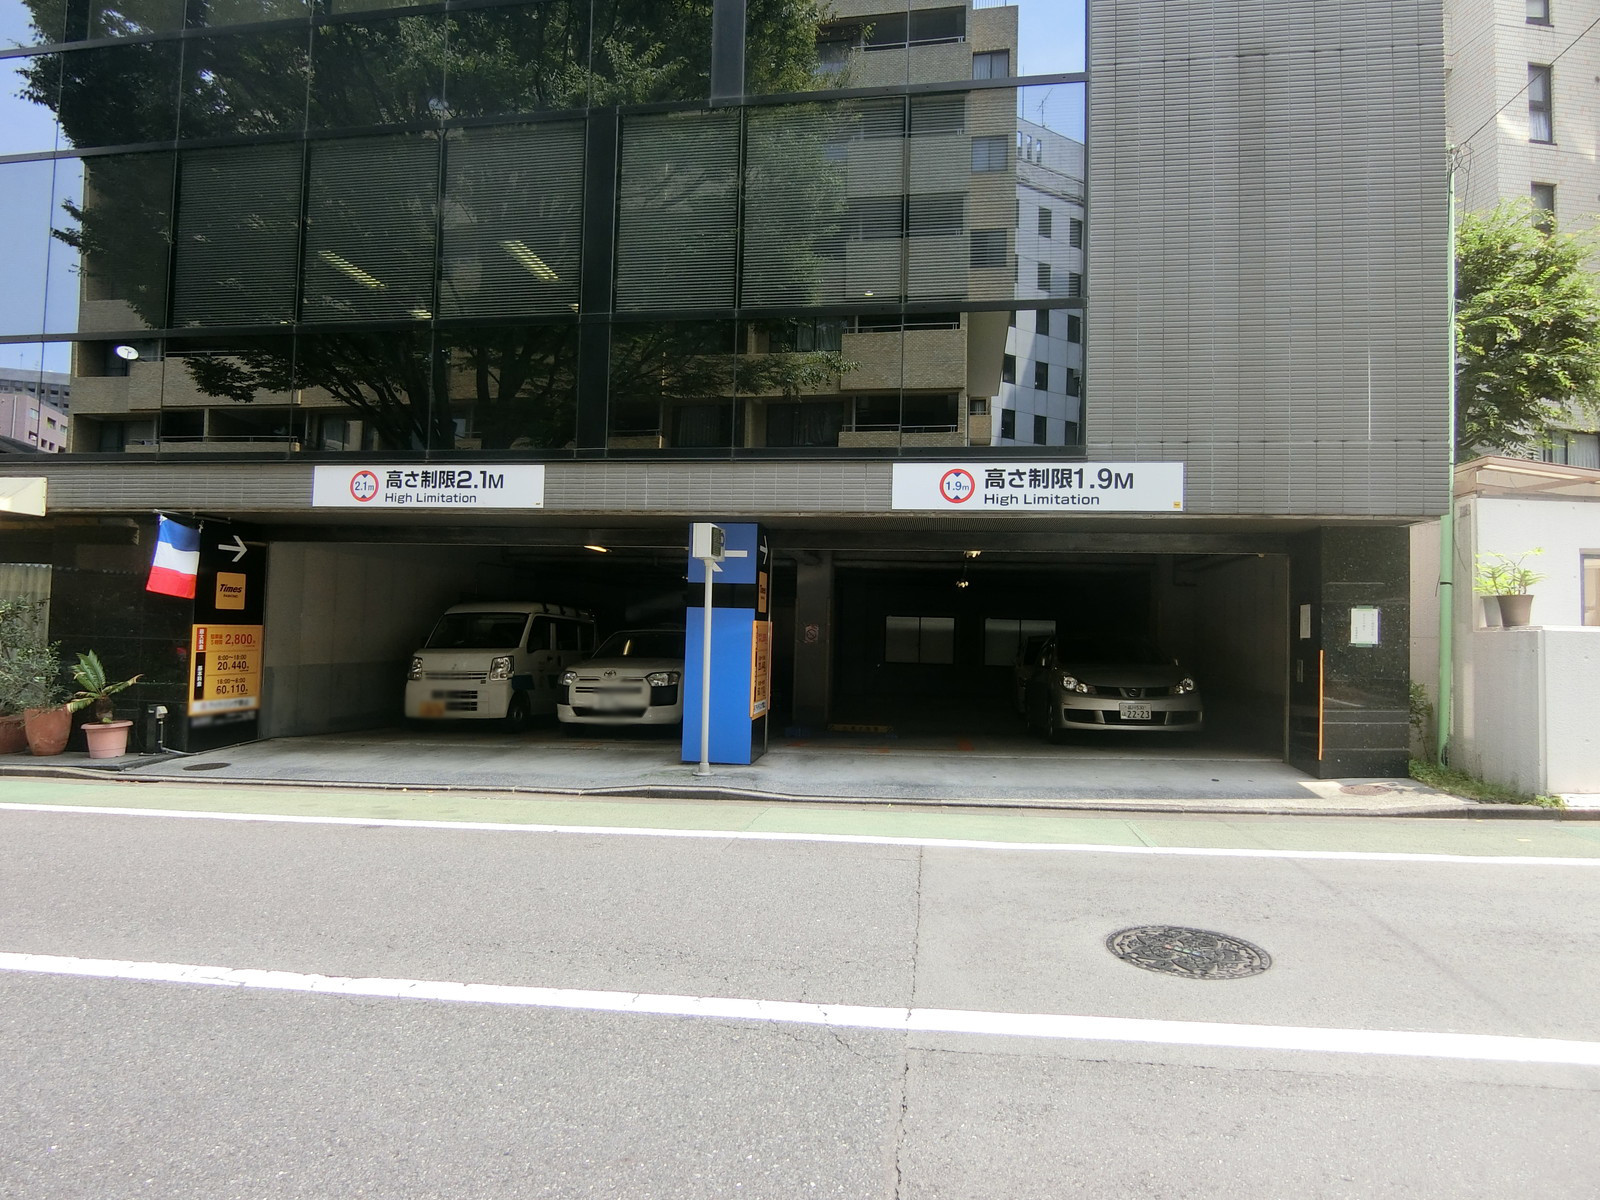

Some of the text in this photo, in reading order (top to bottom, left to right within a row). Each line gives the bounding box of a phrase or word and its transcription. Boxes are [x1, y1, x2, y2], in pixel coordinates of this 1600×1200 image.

[385, 470, 504, 489] 高さ制限2.1M
[984, 468, 1134, 489] 高さ制限1.9M
[354, 481, 375, 491] 2.1m
[945, 481, 970, 491] 1.9m
[384, 493, 477, 504] High Limitation
[984, 494, 1100, 507] High Limitation
[220, 583, 242, 593] Times
